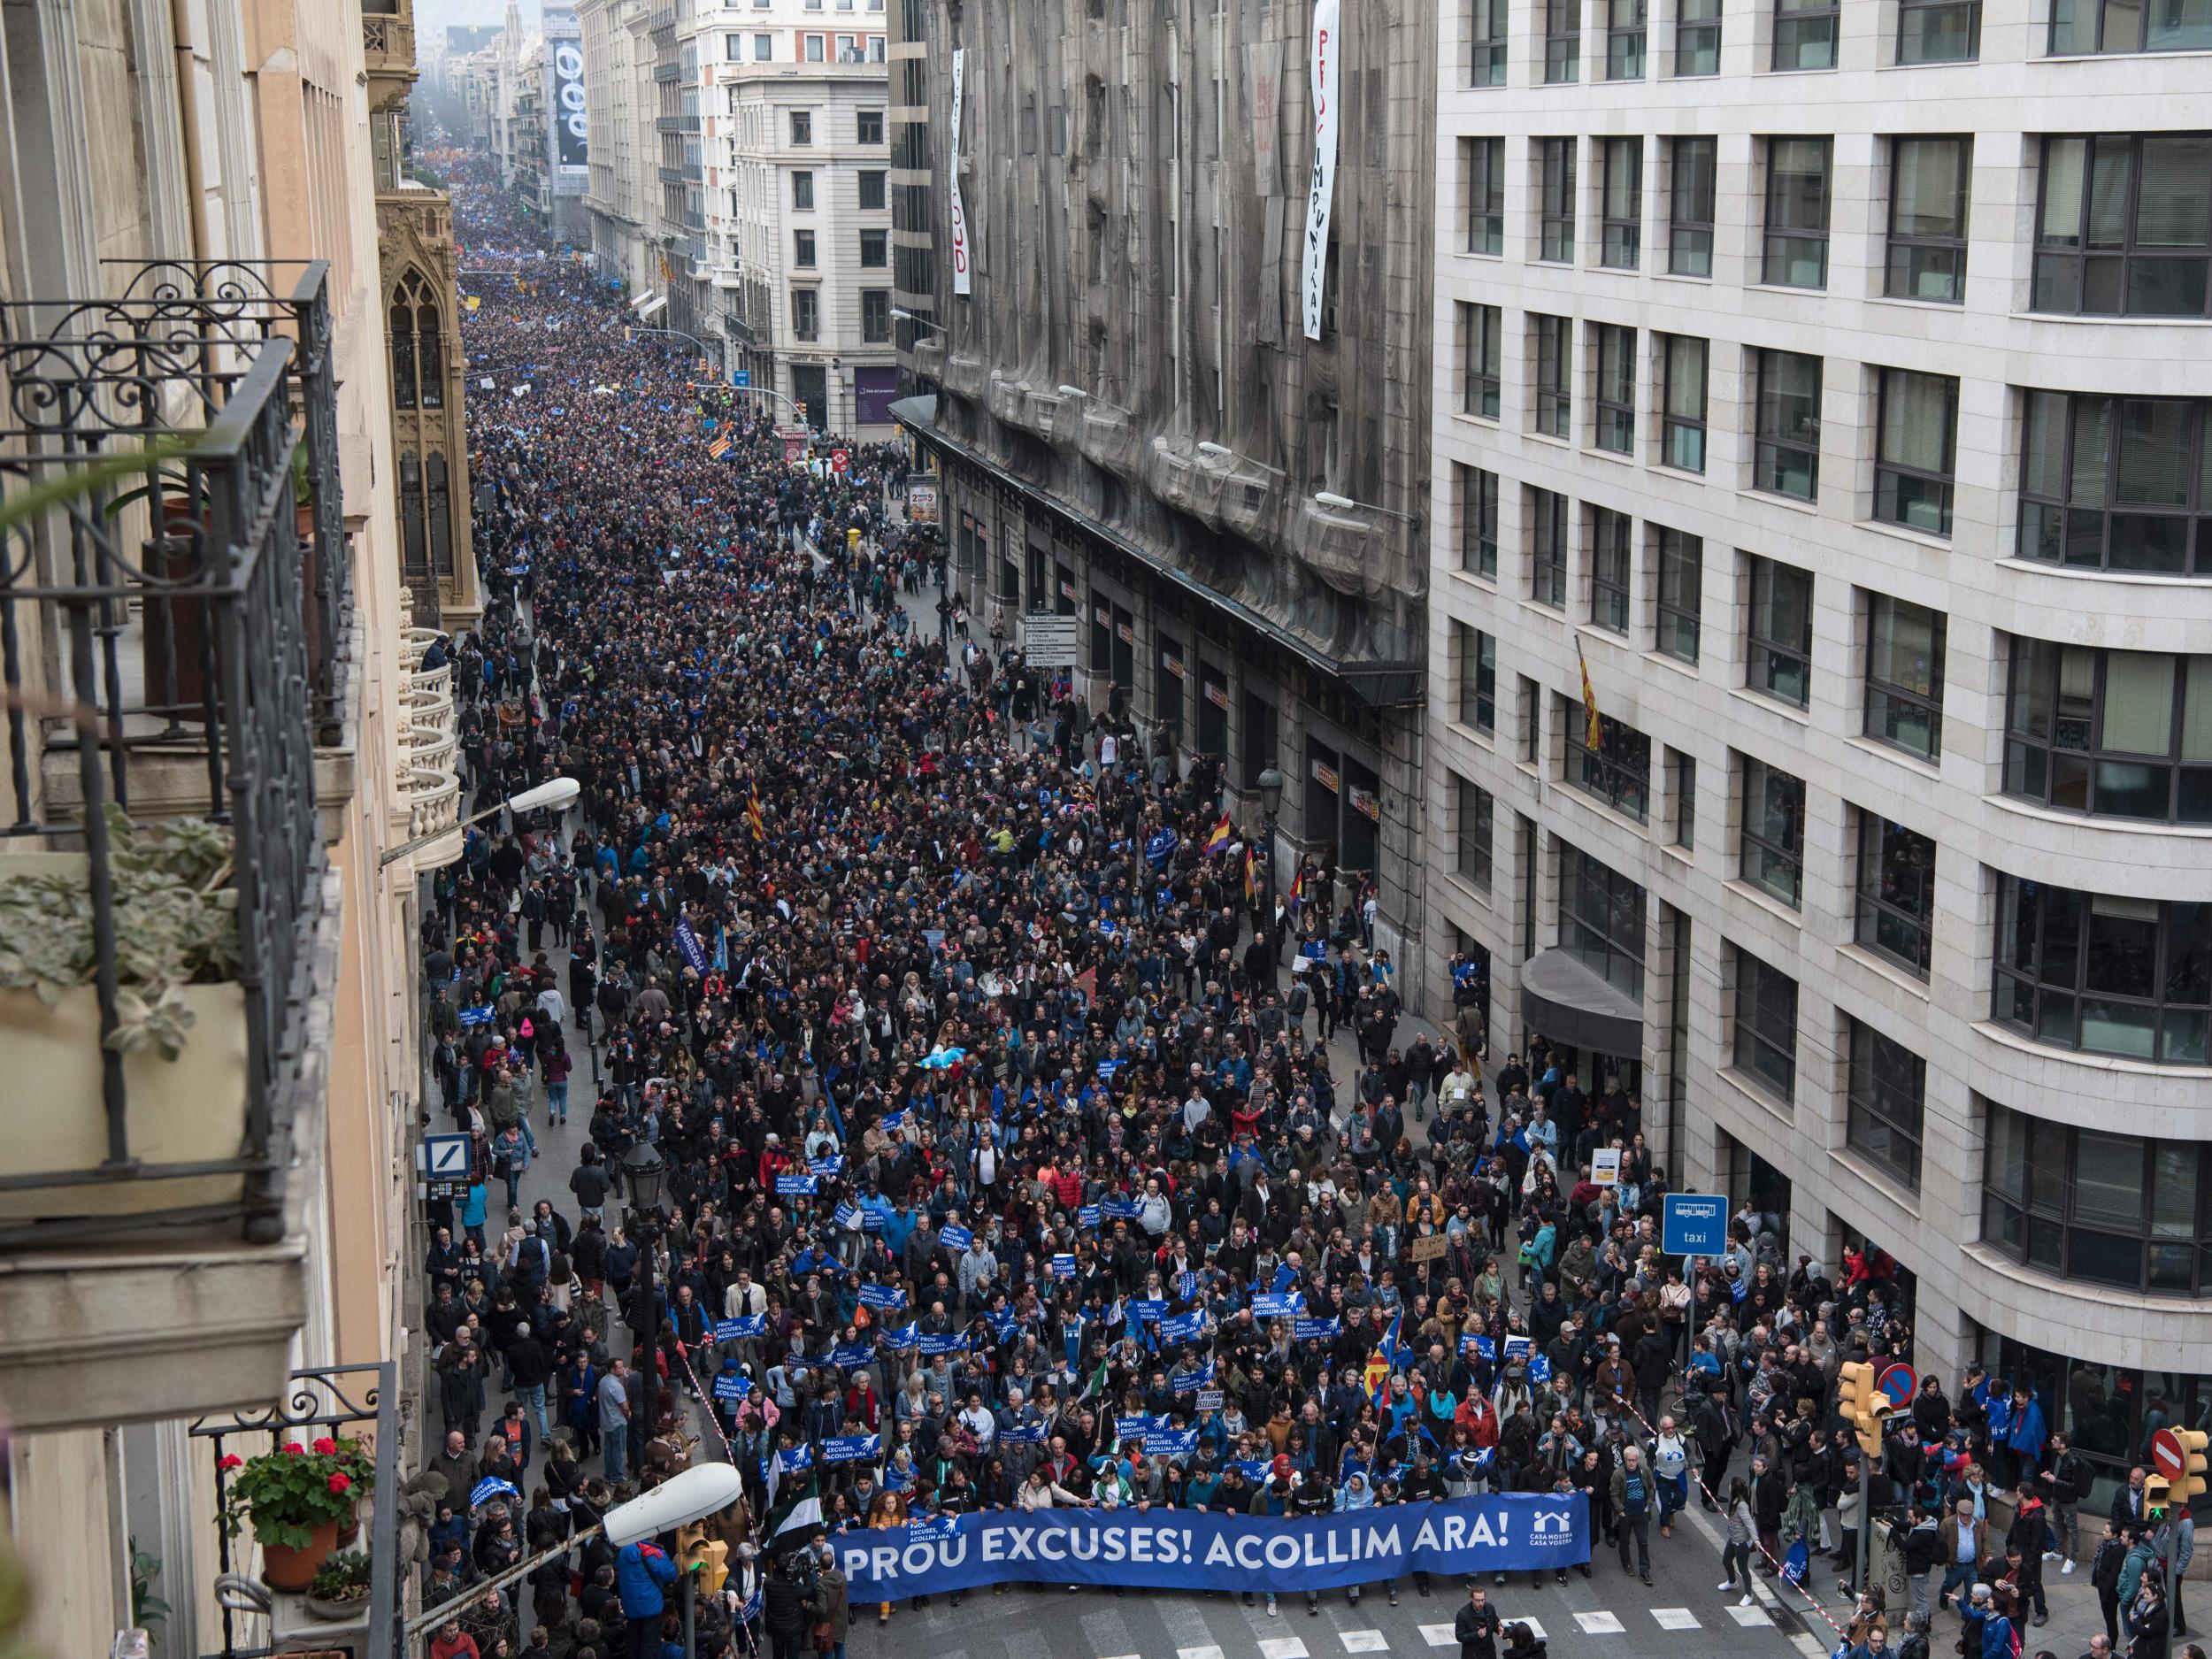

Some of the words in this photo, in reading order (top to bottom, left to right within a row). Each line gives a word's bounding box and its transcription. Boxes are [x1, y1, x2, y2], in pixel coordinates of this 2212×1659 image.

[1685, 1232, 1706, 1243] taxi
[861, 1296, 883, 1305] ACOLLIM
[717, 1383, 742, 1392] EXCUSES,
[844, 1533, 966, 1581] PROU
[982, 1526, 1192, 1565] EXCUSES!
[1204, 1523, 1402, 1570] ACOLLIM
[1412, 1512, 1509, 1553] ARA!
